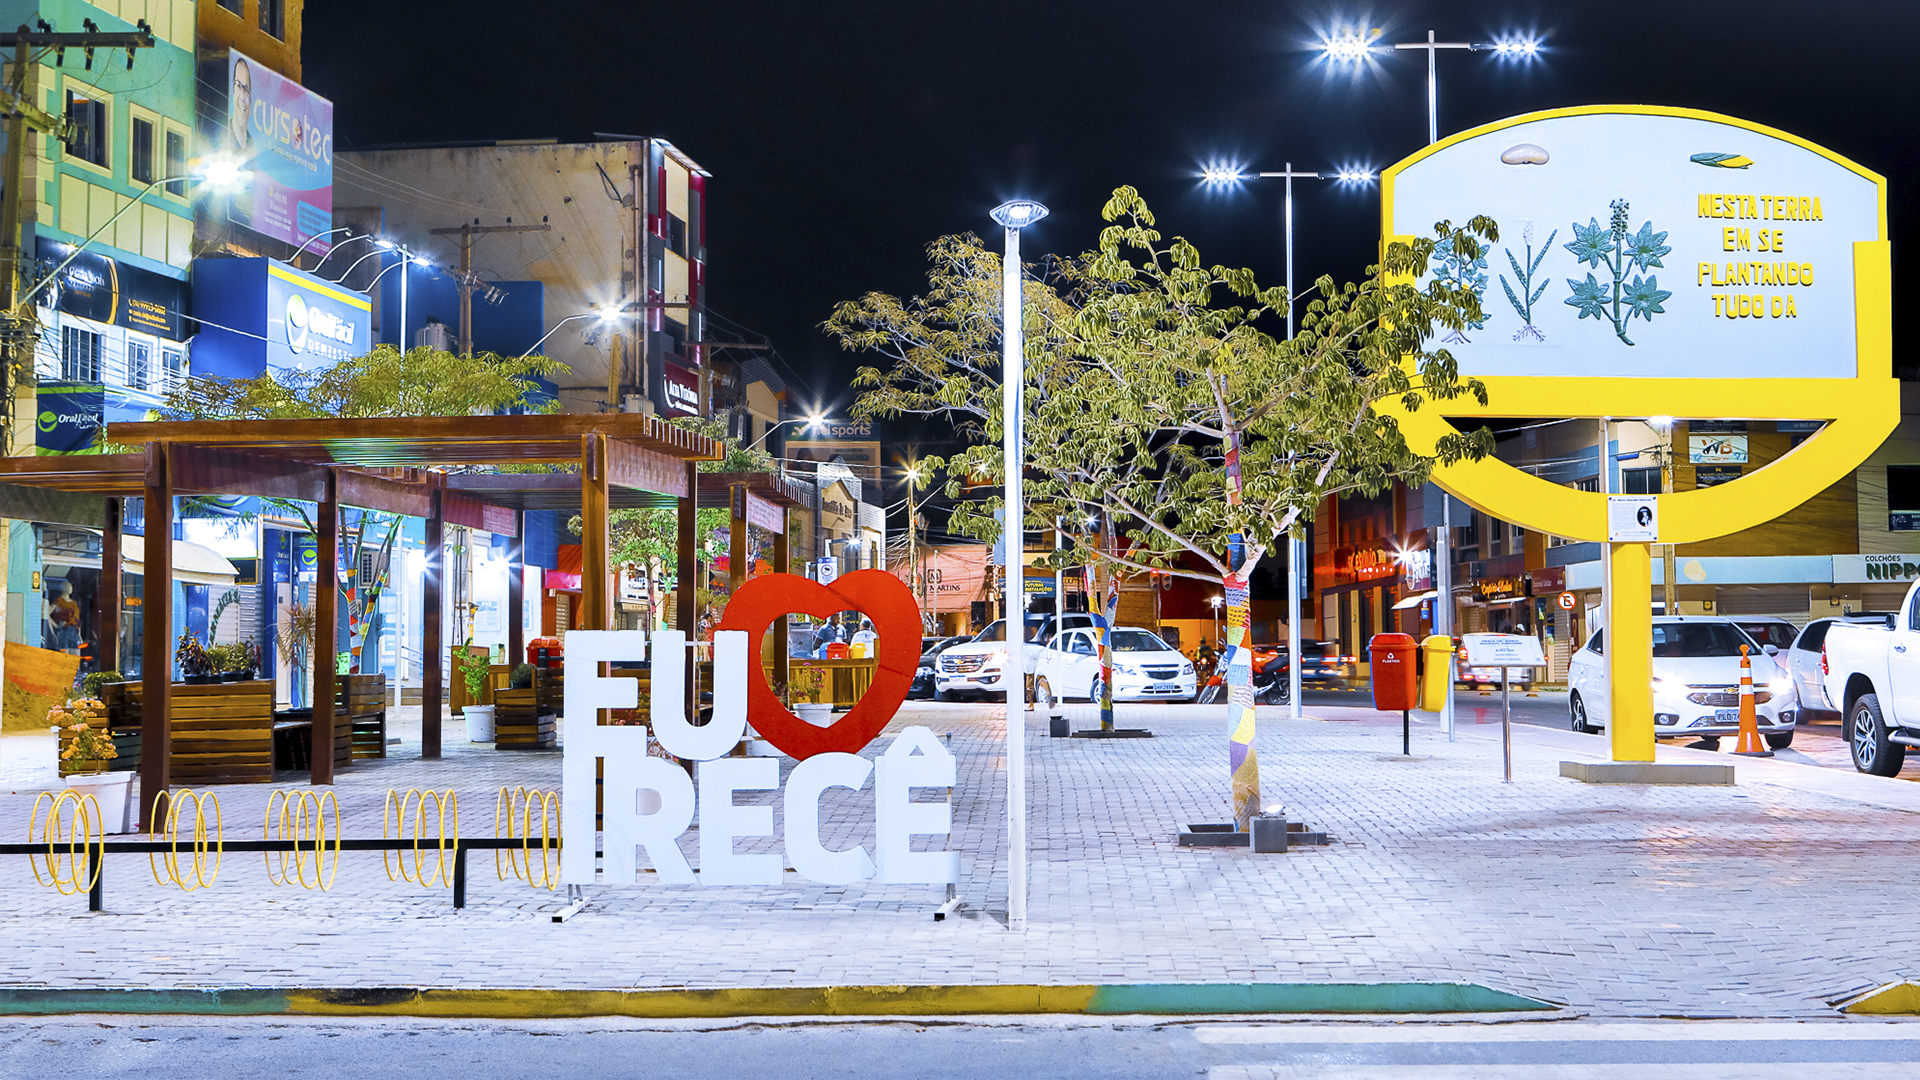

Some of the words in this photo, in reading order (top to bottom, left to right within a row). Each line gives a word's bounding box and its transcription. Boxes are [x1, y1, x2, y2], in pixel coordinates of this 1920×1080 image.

[1698, 194, 1758, 220] NESTA
[1760, 195, 1823, 221] TERRA
[1723, 227, 1751, 252] EM
[1758, 228, 1784, 253] SE
[1698, 262, 1814, 286] PLANTANDO
[1712, 294, 1764, 319] TUDO
[1771, 294, 1797, 318] DA
[1866, 562, 1920, 580] NIPP
[563, 630, 749, 762] EU
[563, 726, 961, 886] IRECÊ
